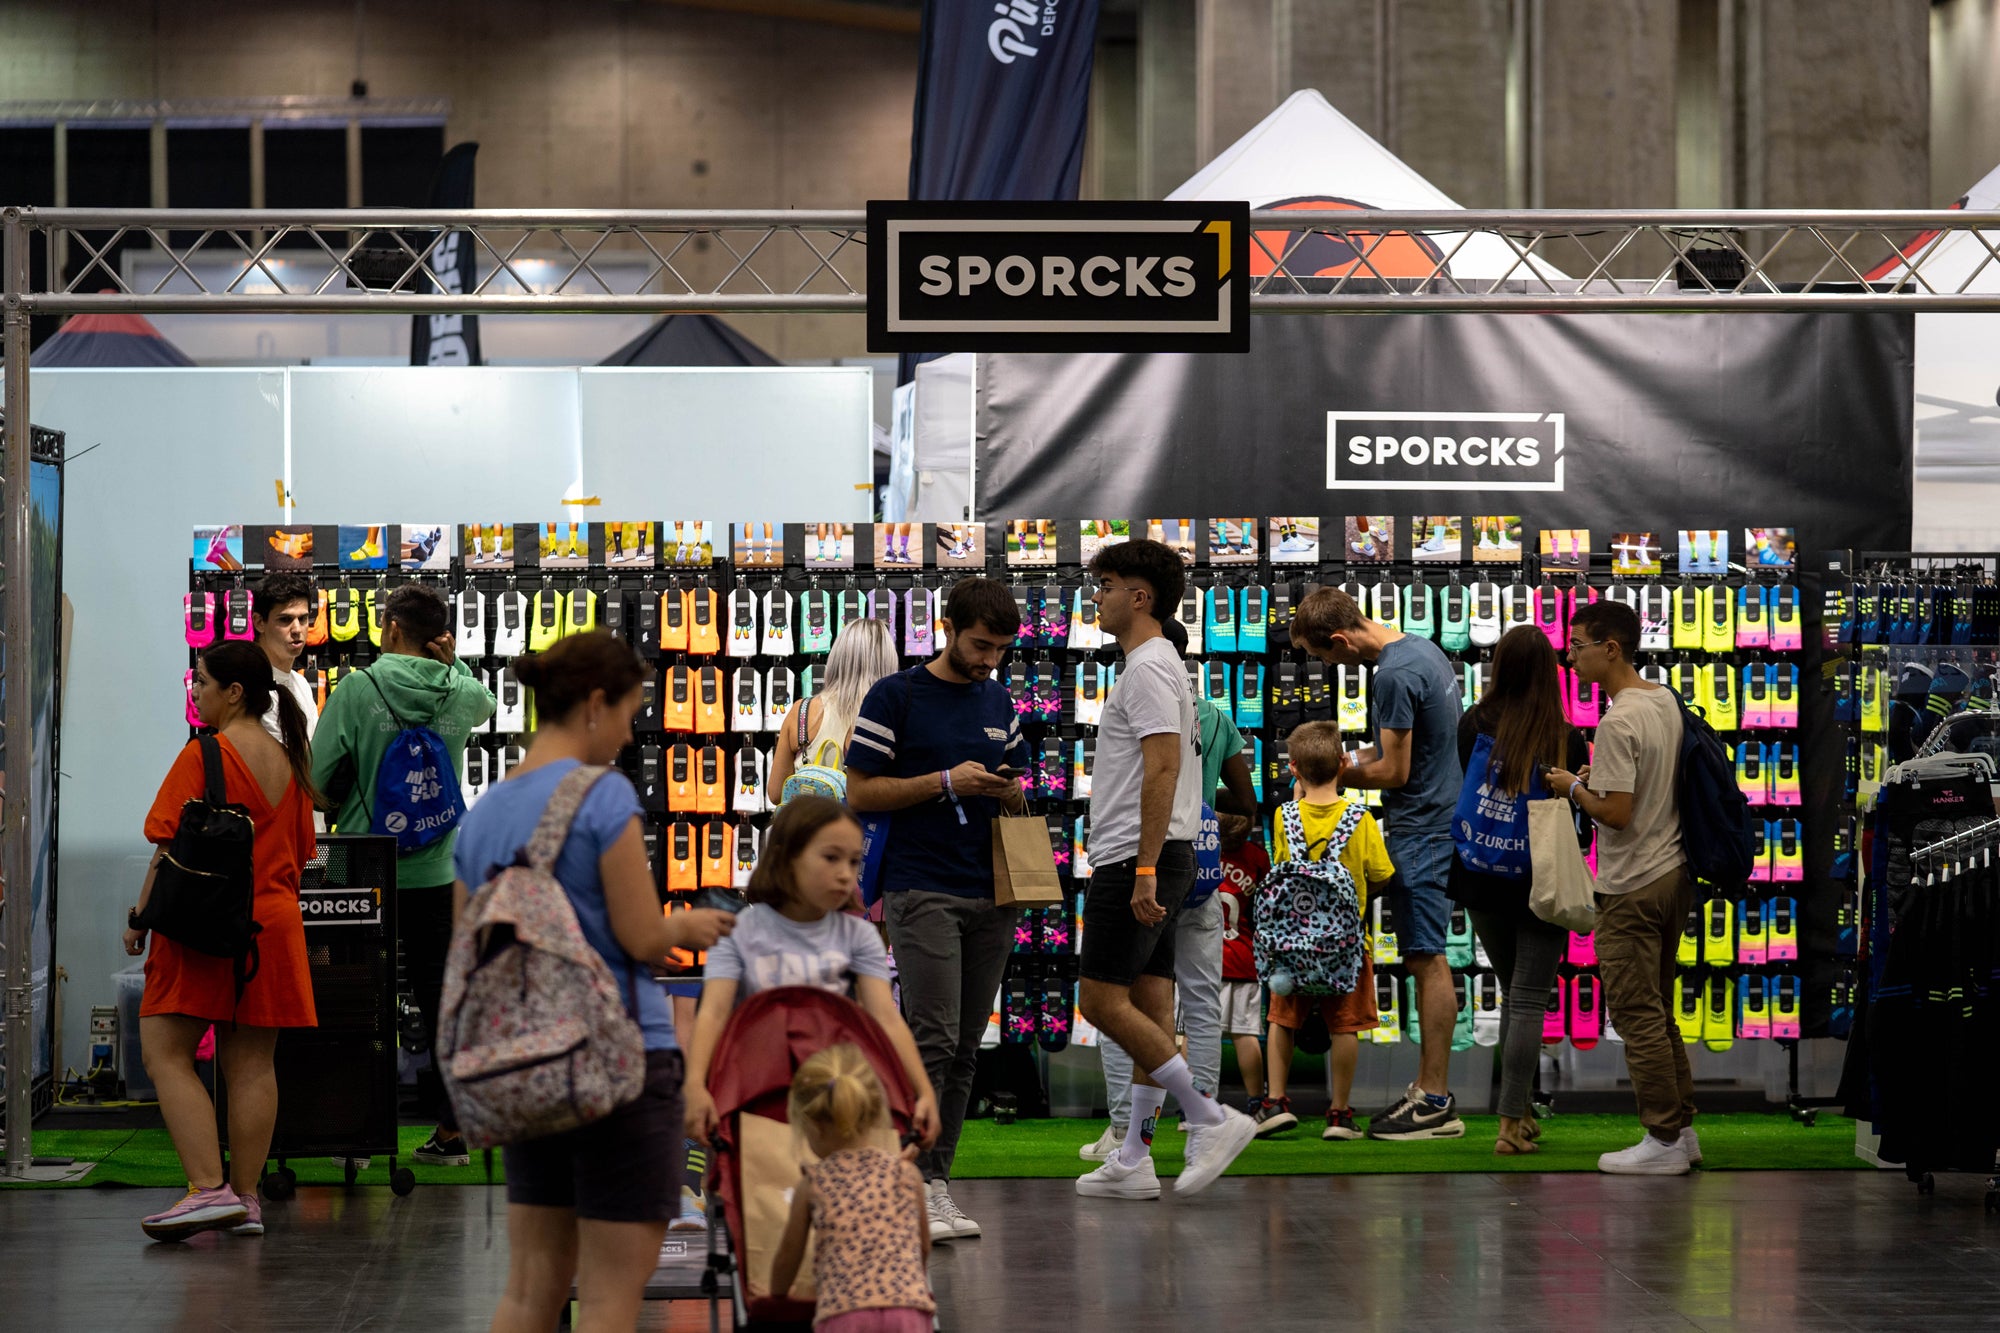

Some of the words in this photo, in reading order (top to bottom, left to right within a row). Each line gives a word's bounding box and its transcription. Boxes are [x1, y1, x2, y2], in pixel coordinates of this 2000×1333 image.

[918, 255, 1196, 297] SPORCKS
[1348, 436, 1540, 466] SPORCKS
[439, 726, 461, 736] RACE
[1474, 832, 1525, 851] ZURICH
[1197, 867, 1223, 880] RIC
[1220, 861, 1257, 897] FORD
[298, 899, 371, 915] PORCKS
